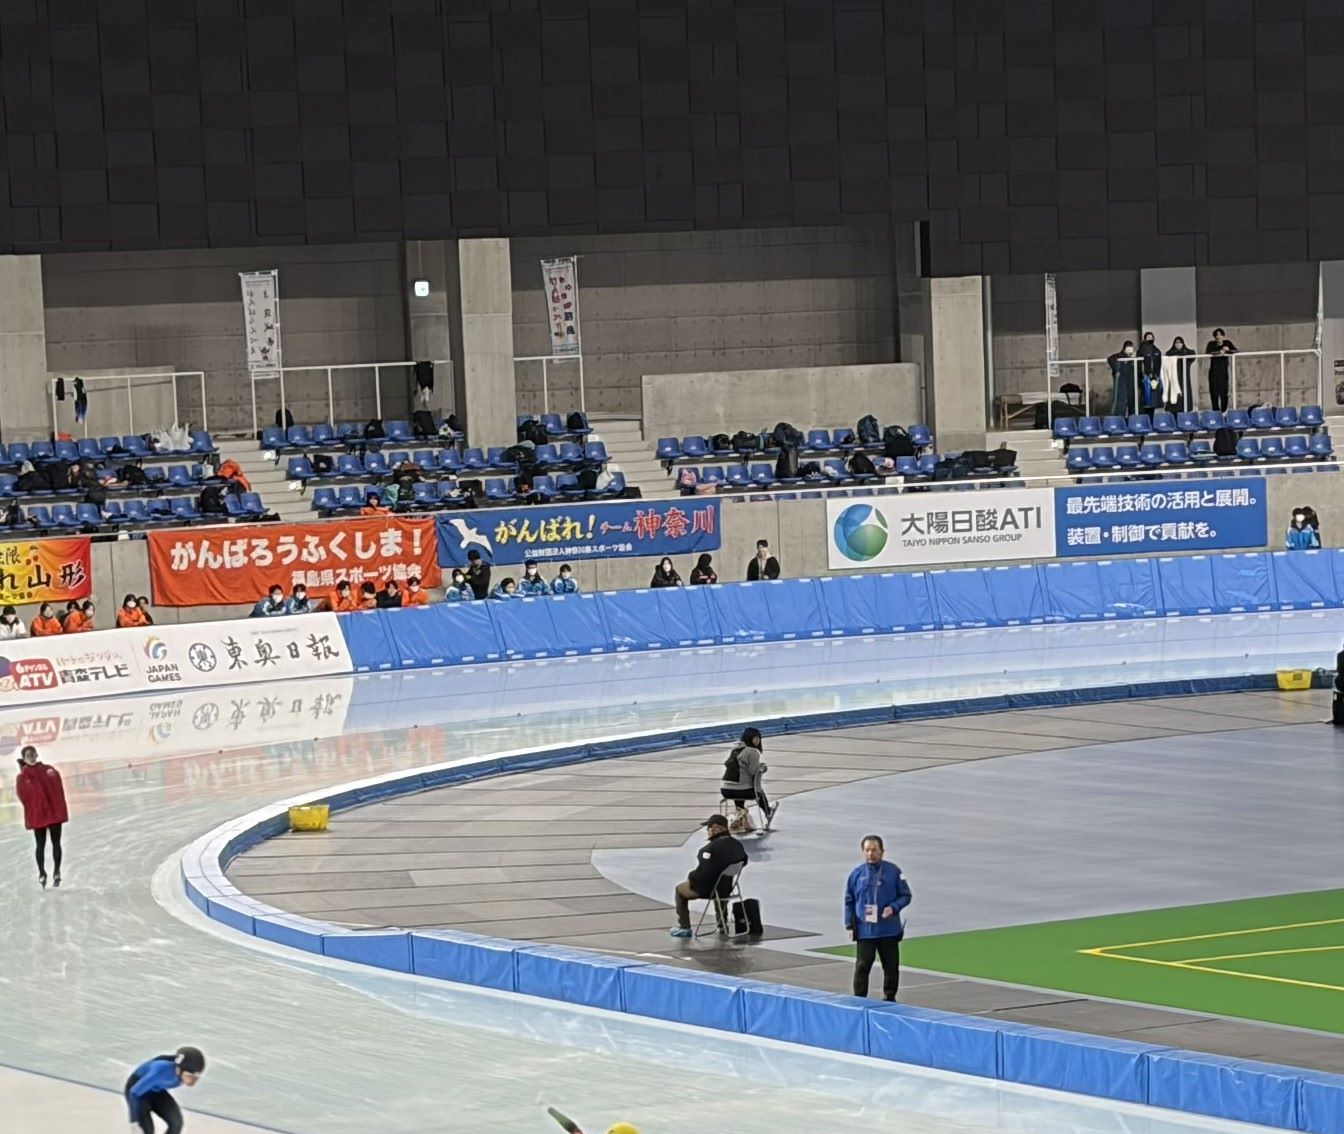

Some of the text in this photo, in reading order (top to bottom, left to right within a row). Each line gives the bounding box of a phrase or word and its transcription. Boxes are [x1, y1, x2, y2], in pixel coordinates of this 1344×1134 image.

[1066, 488, 1256, 514] 最先端技術の活用と展開。
[901, 506, 1042, 536] 大陽日酸ATI
[902, 533, 1023, 548] TAIYO NIPPON SANSO GROUP
[1067, 522, 1217, 546] 装置・制御で貢献を。
[170, 528, 423, 571] がんばろうふくしま！
[220, 632, 339, 670] 東奥日報
[59, 664, 130, 684] 青森テレビ
[146, 663, 179, 674] JAPAN
[148, 672, 182, 683] GAMES
[19, 672, 53, 688] ATV
